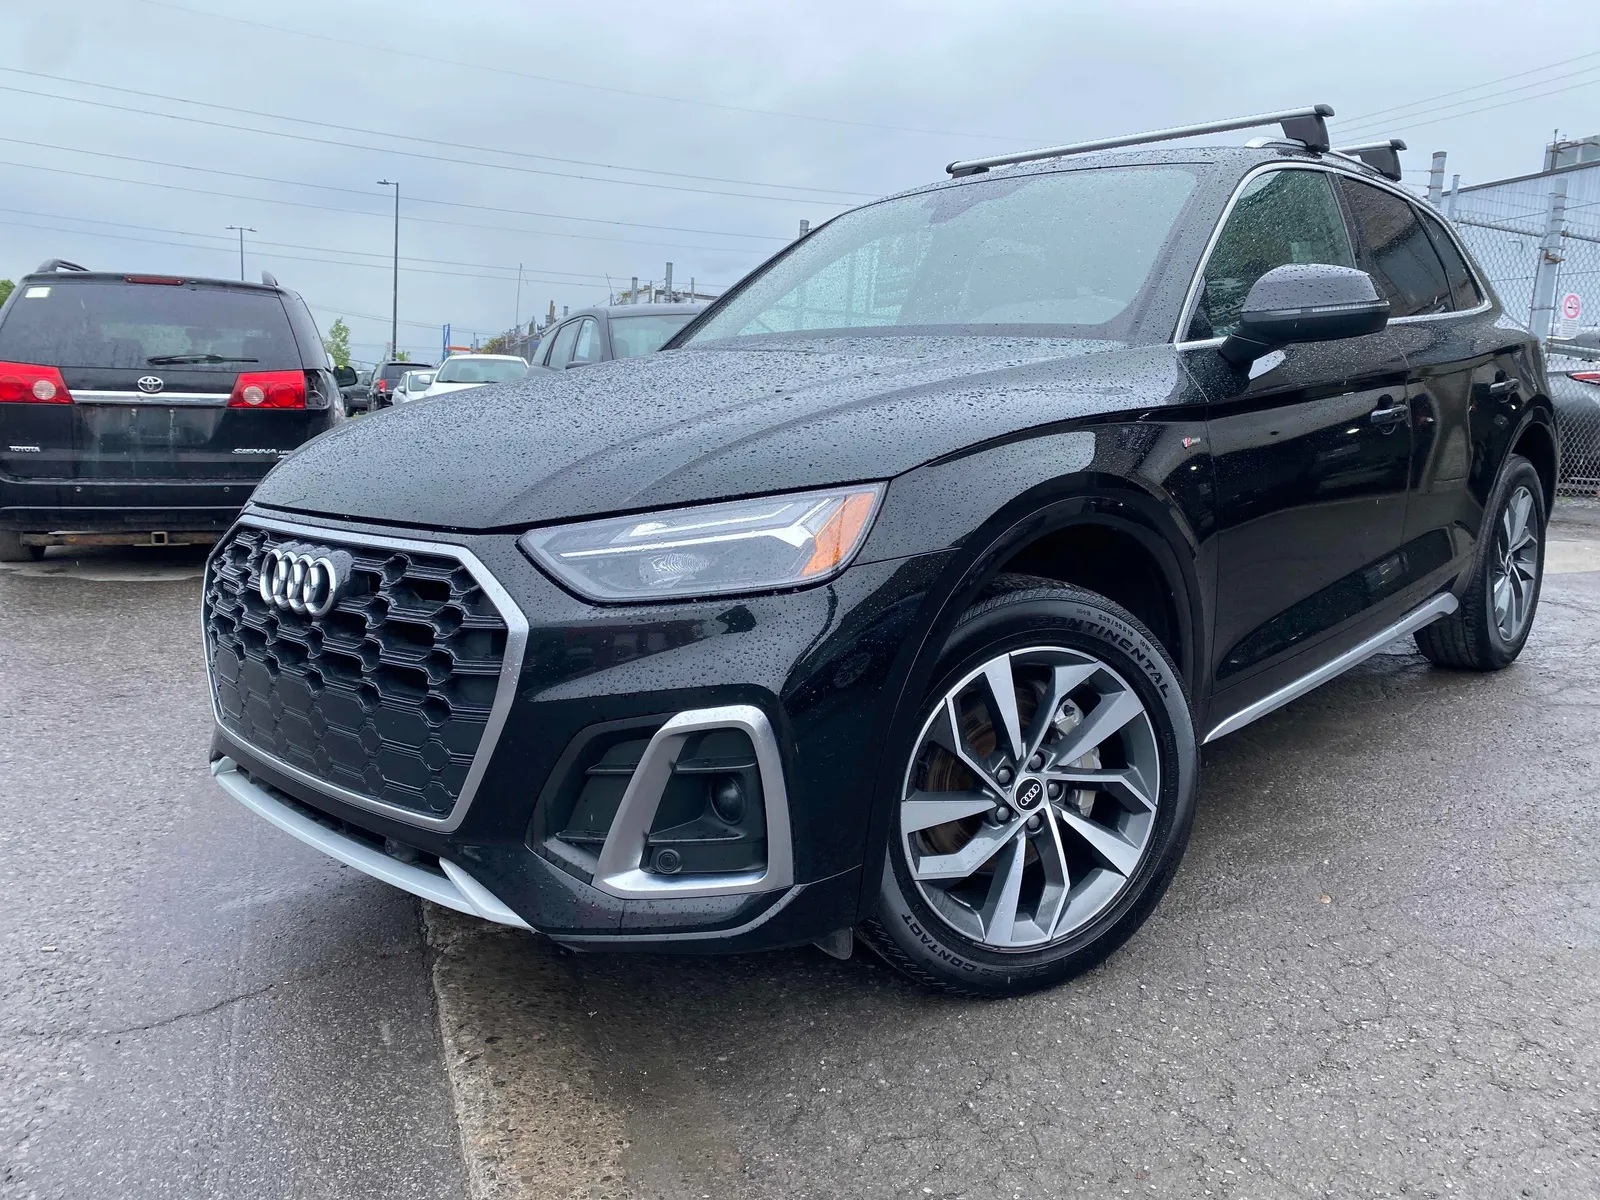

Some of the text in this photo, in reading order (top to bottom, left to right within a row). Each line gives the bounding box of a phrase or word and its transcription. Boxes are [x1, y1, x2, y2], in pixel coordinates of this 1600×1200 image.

[9, 445, 40, 453] TOYOTA
[1031, 615, 1169, 698] CONTINENTAL
[901, 913, 978, 972] CONTACT
